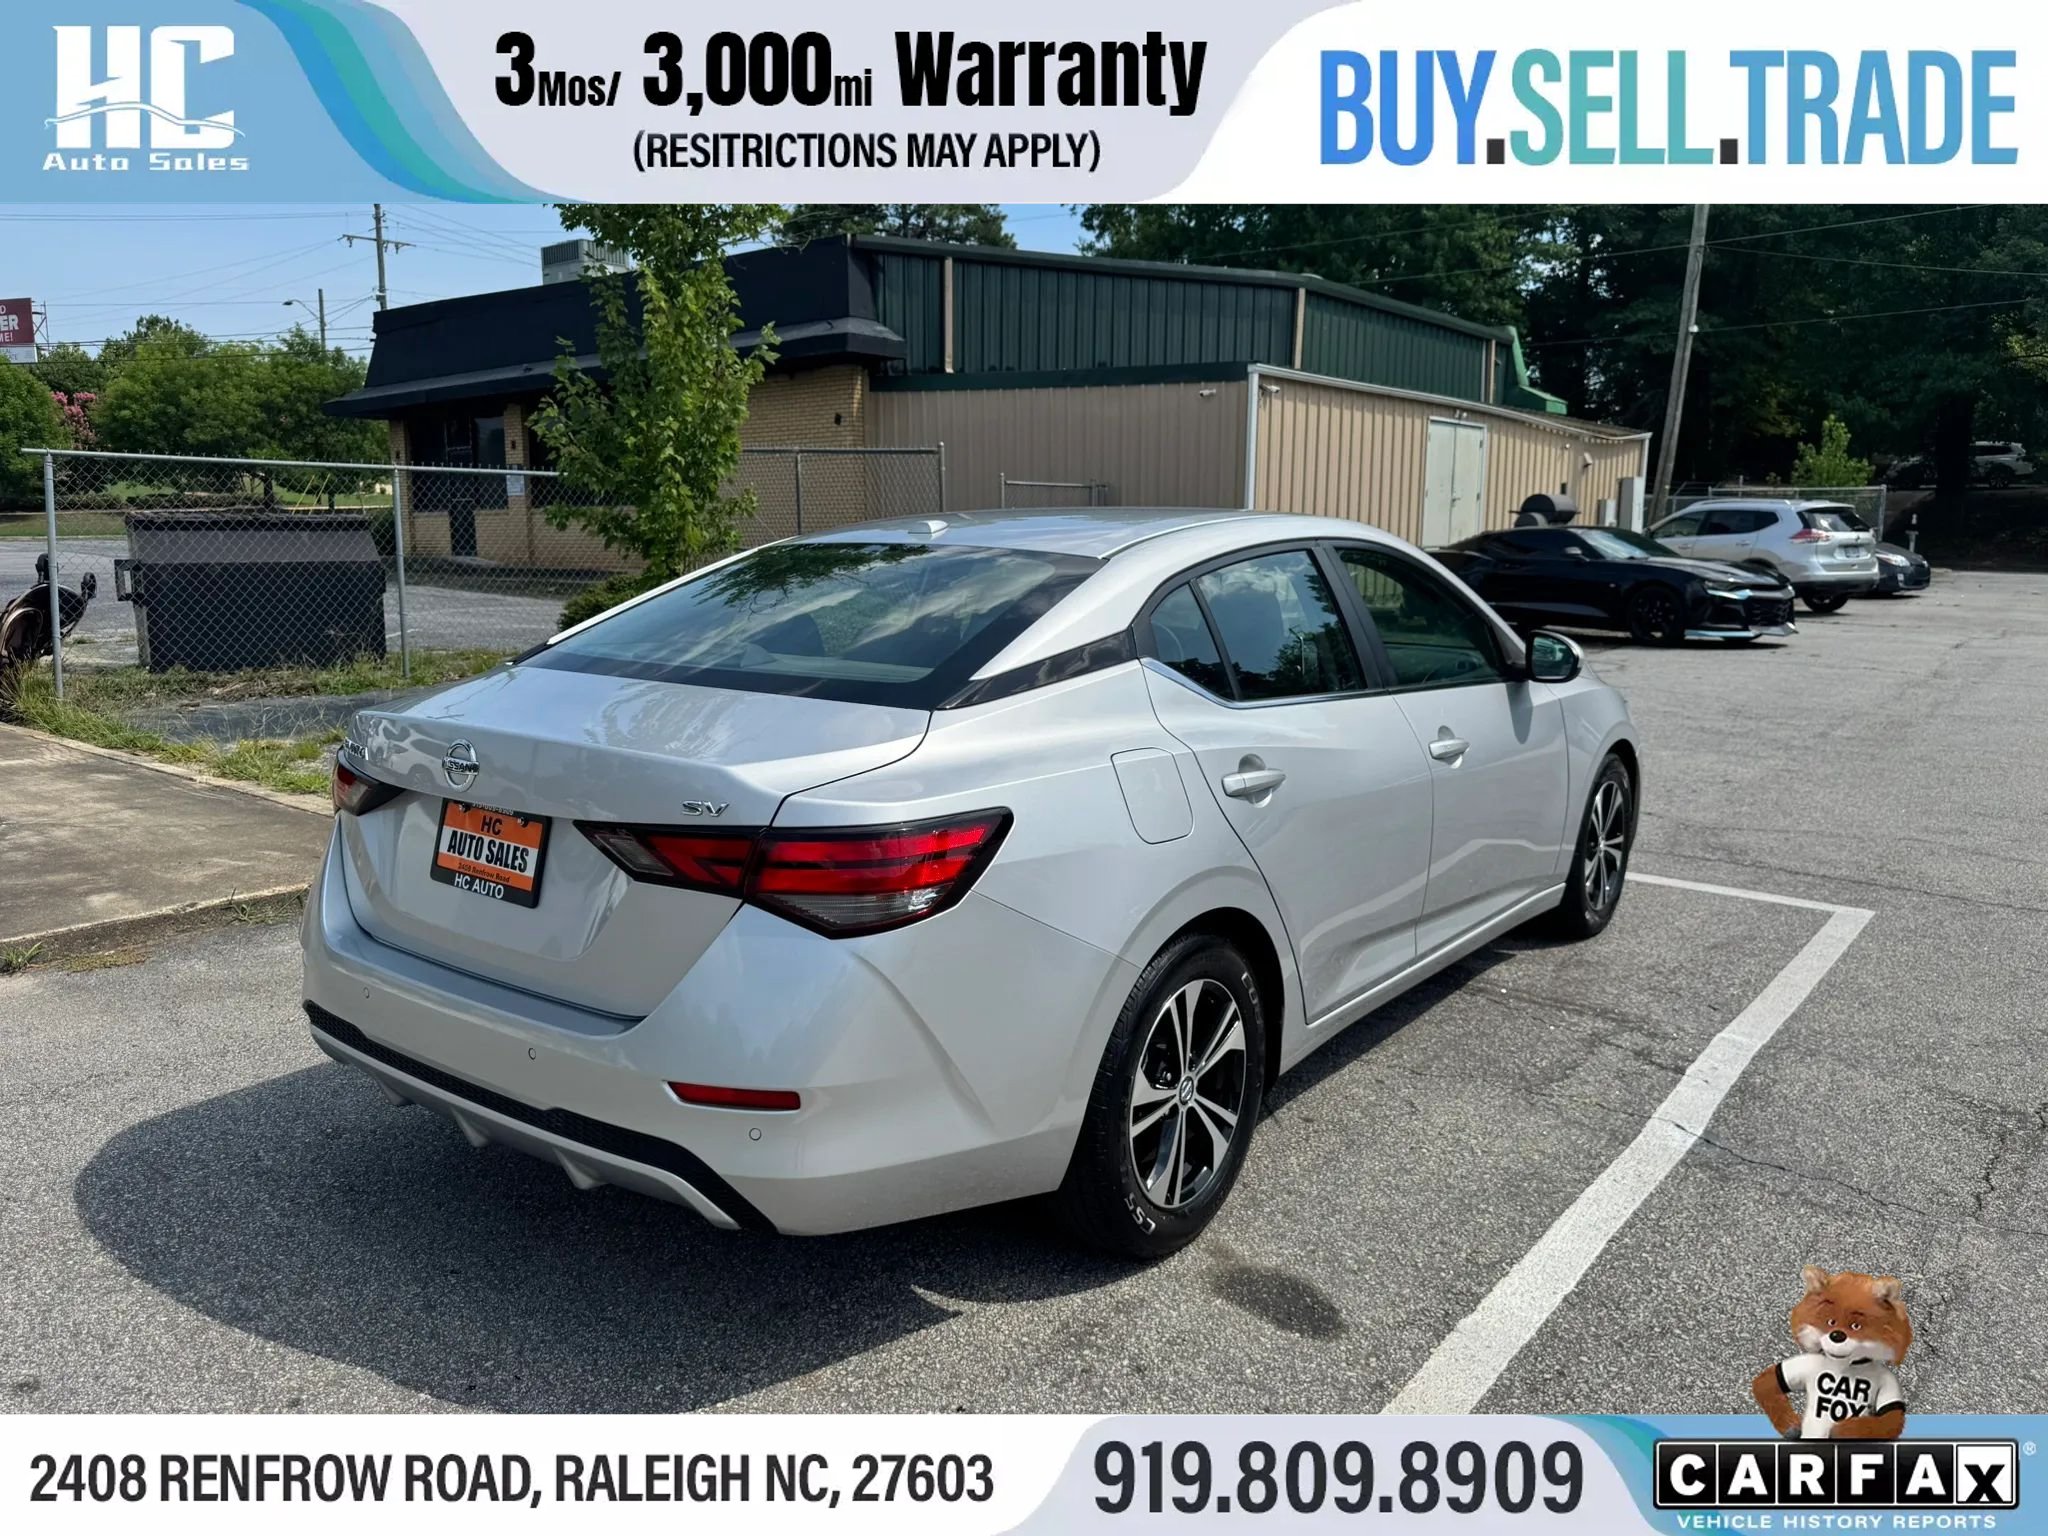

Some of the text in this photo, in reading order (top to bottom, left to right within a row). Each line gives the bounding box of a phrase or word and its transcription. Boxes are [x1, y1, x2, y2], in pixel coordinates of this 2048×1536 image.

[681, 800, 730, 817] SV
[481, 815, 503, 836] HC
[447, 830, 530, 873] AUTO SALES
[454, 873, 504, 899] HC AUTO
